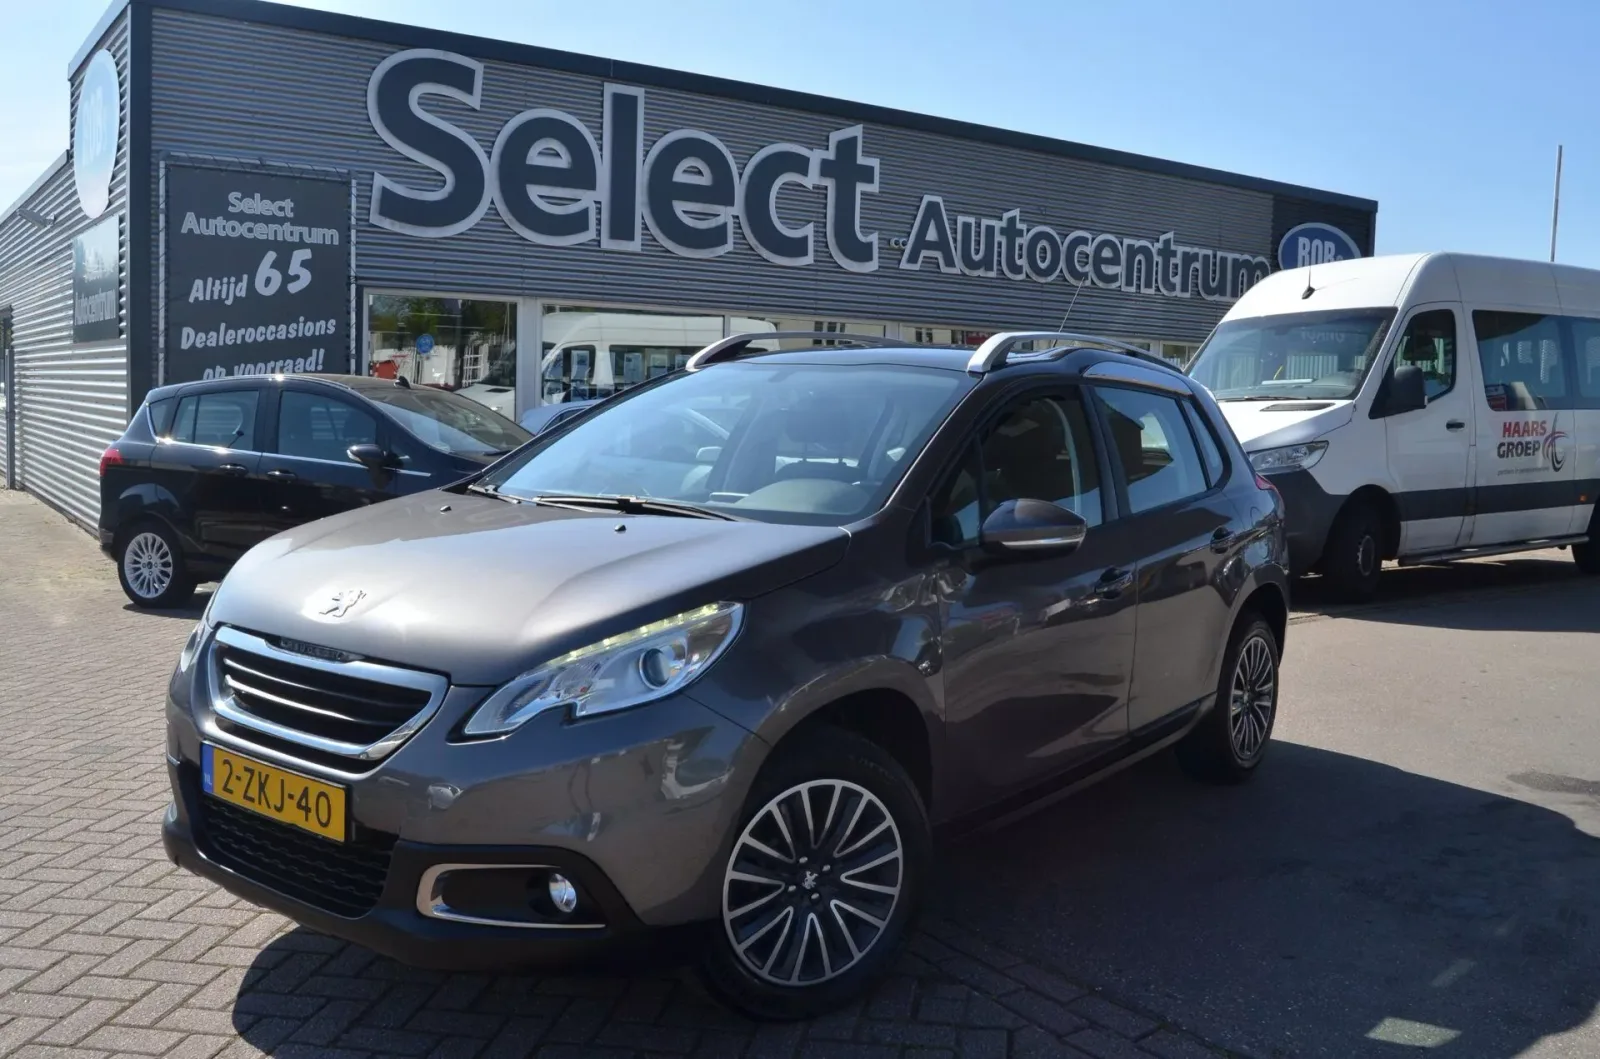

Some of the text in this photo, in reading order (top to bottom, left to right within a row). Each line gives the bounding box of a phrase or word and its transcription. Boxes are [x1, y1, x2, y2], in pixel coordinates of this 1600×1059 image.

[366, 48, 1270, 303] Select Autocentrum
[228, 192, 294, 217] Select
[181, 212, 340, 245] Autocentrum
[188, 248, 313, 305] Altijd 65
[181, 316, 336, 349] Dealeroccasions
[1502, 420, 1547, 438] HAARS
[1497, 440, 1540, 458] GROEP
[221, 758, 332, 828] 2-ZKJ-40
